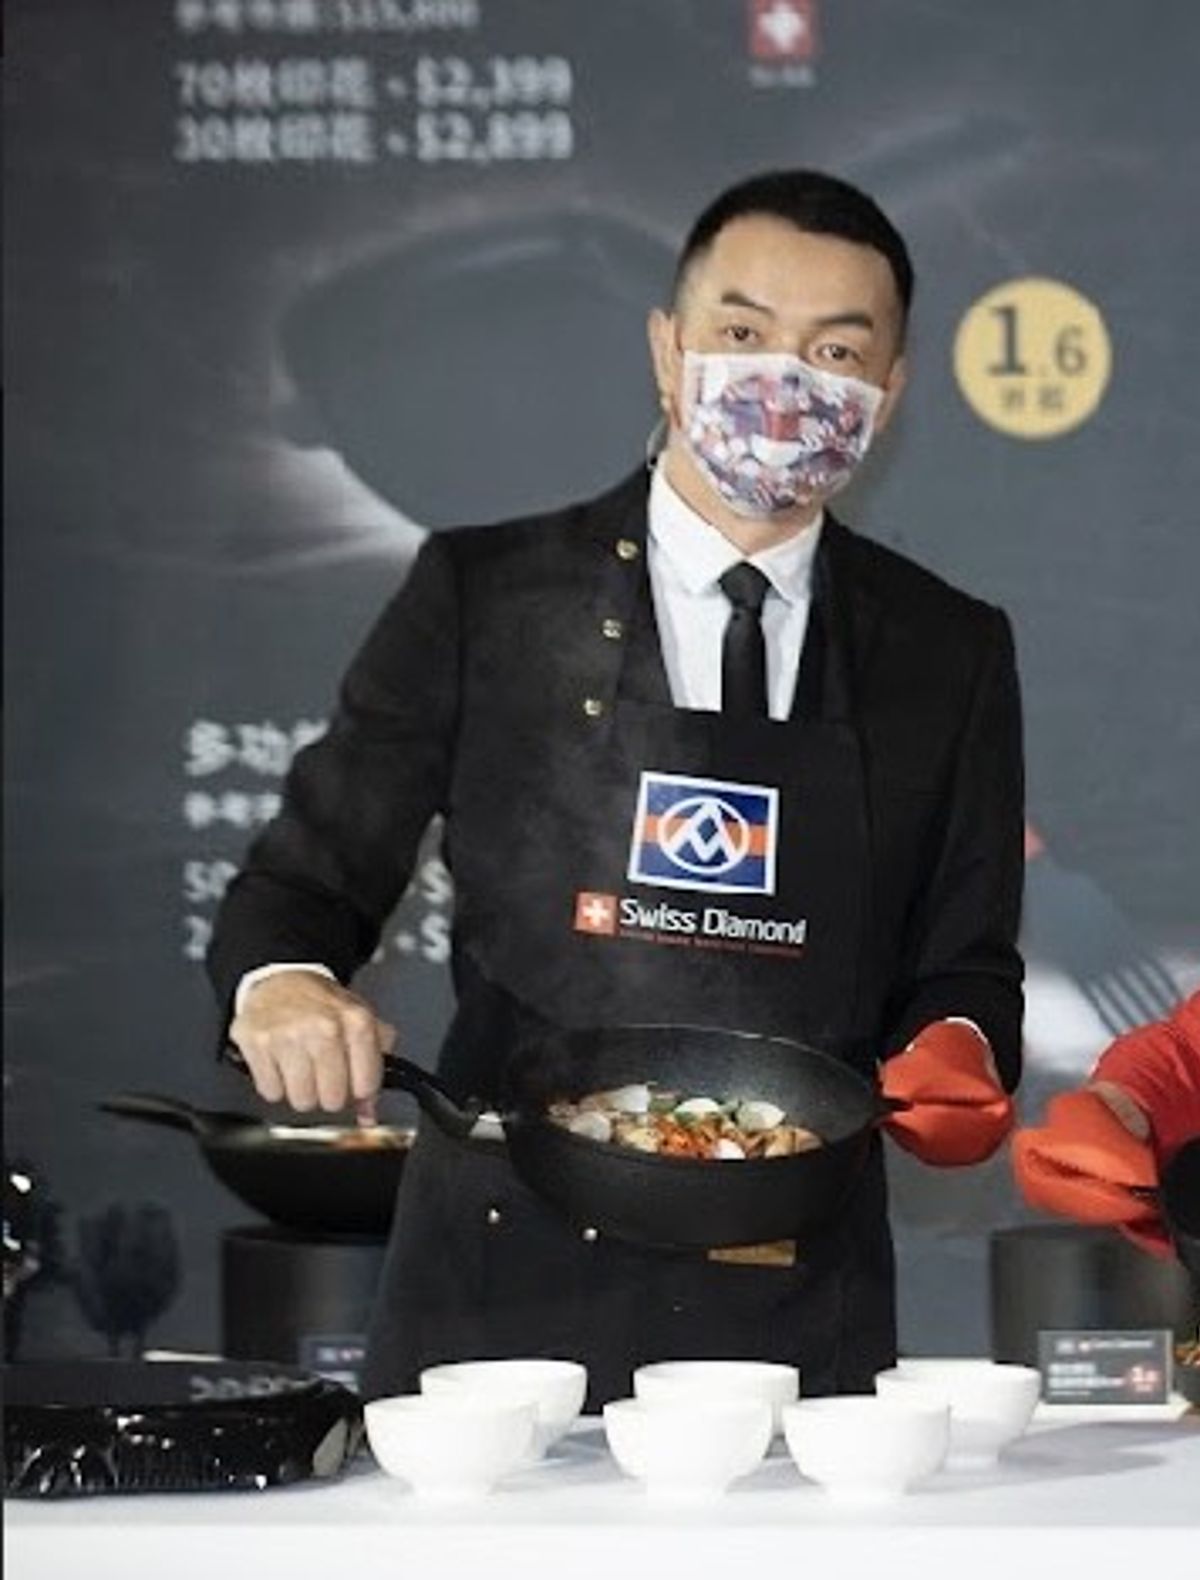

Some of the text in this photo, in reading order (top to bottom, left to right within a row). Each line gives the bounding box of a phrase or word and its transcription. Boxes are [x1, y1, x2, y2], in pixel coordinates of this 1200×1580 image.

[987, 304, 1088, 377] 1.6
[620, 898, 697, 934] Swiss
[703, 908, 807, 945] Diamond
